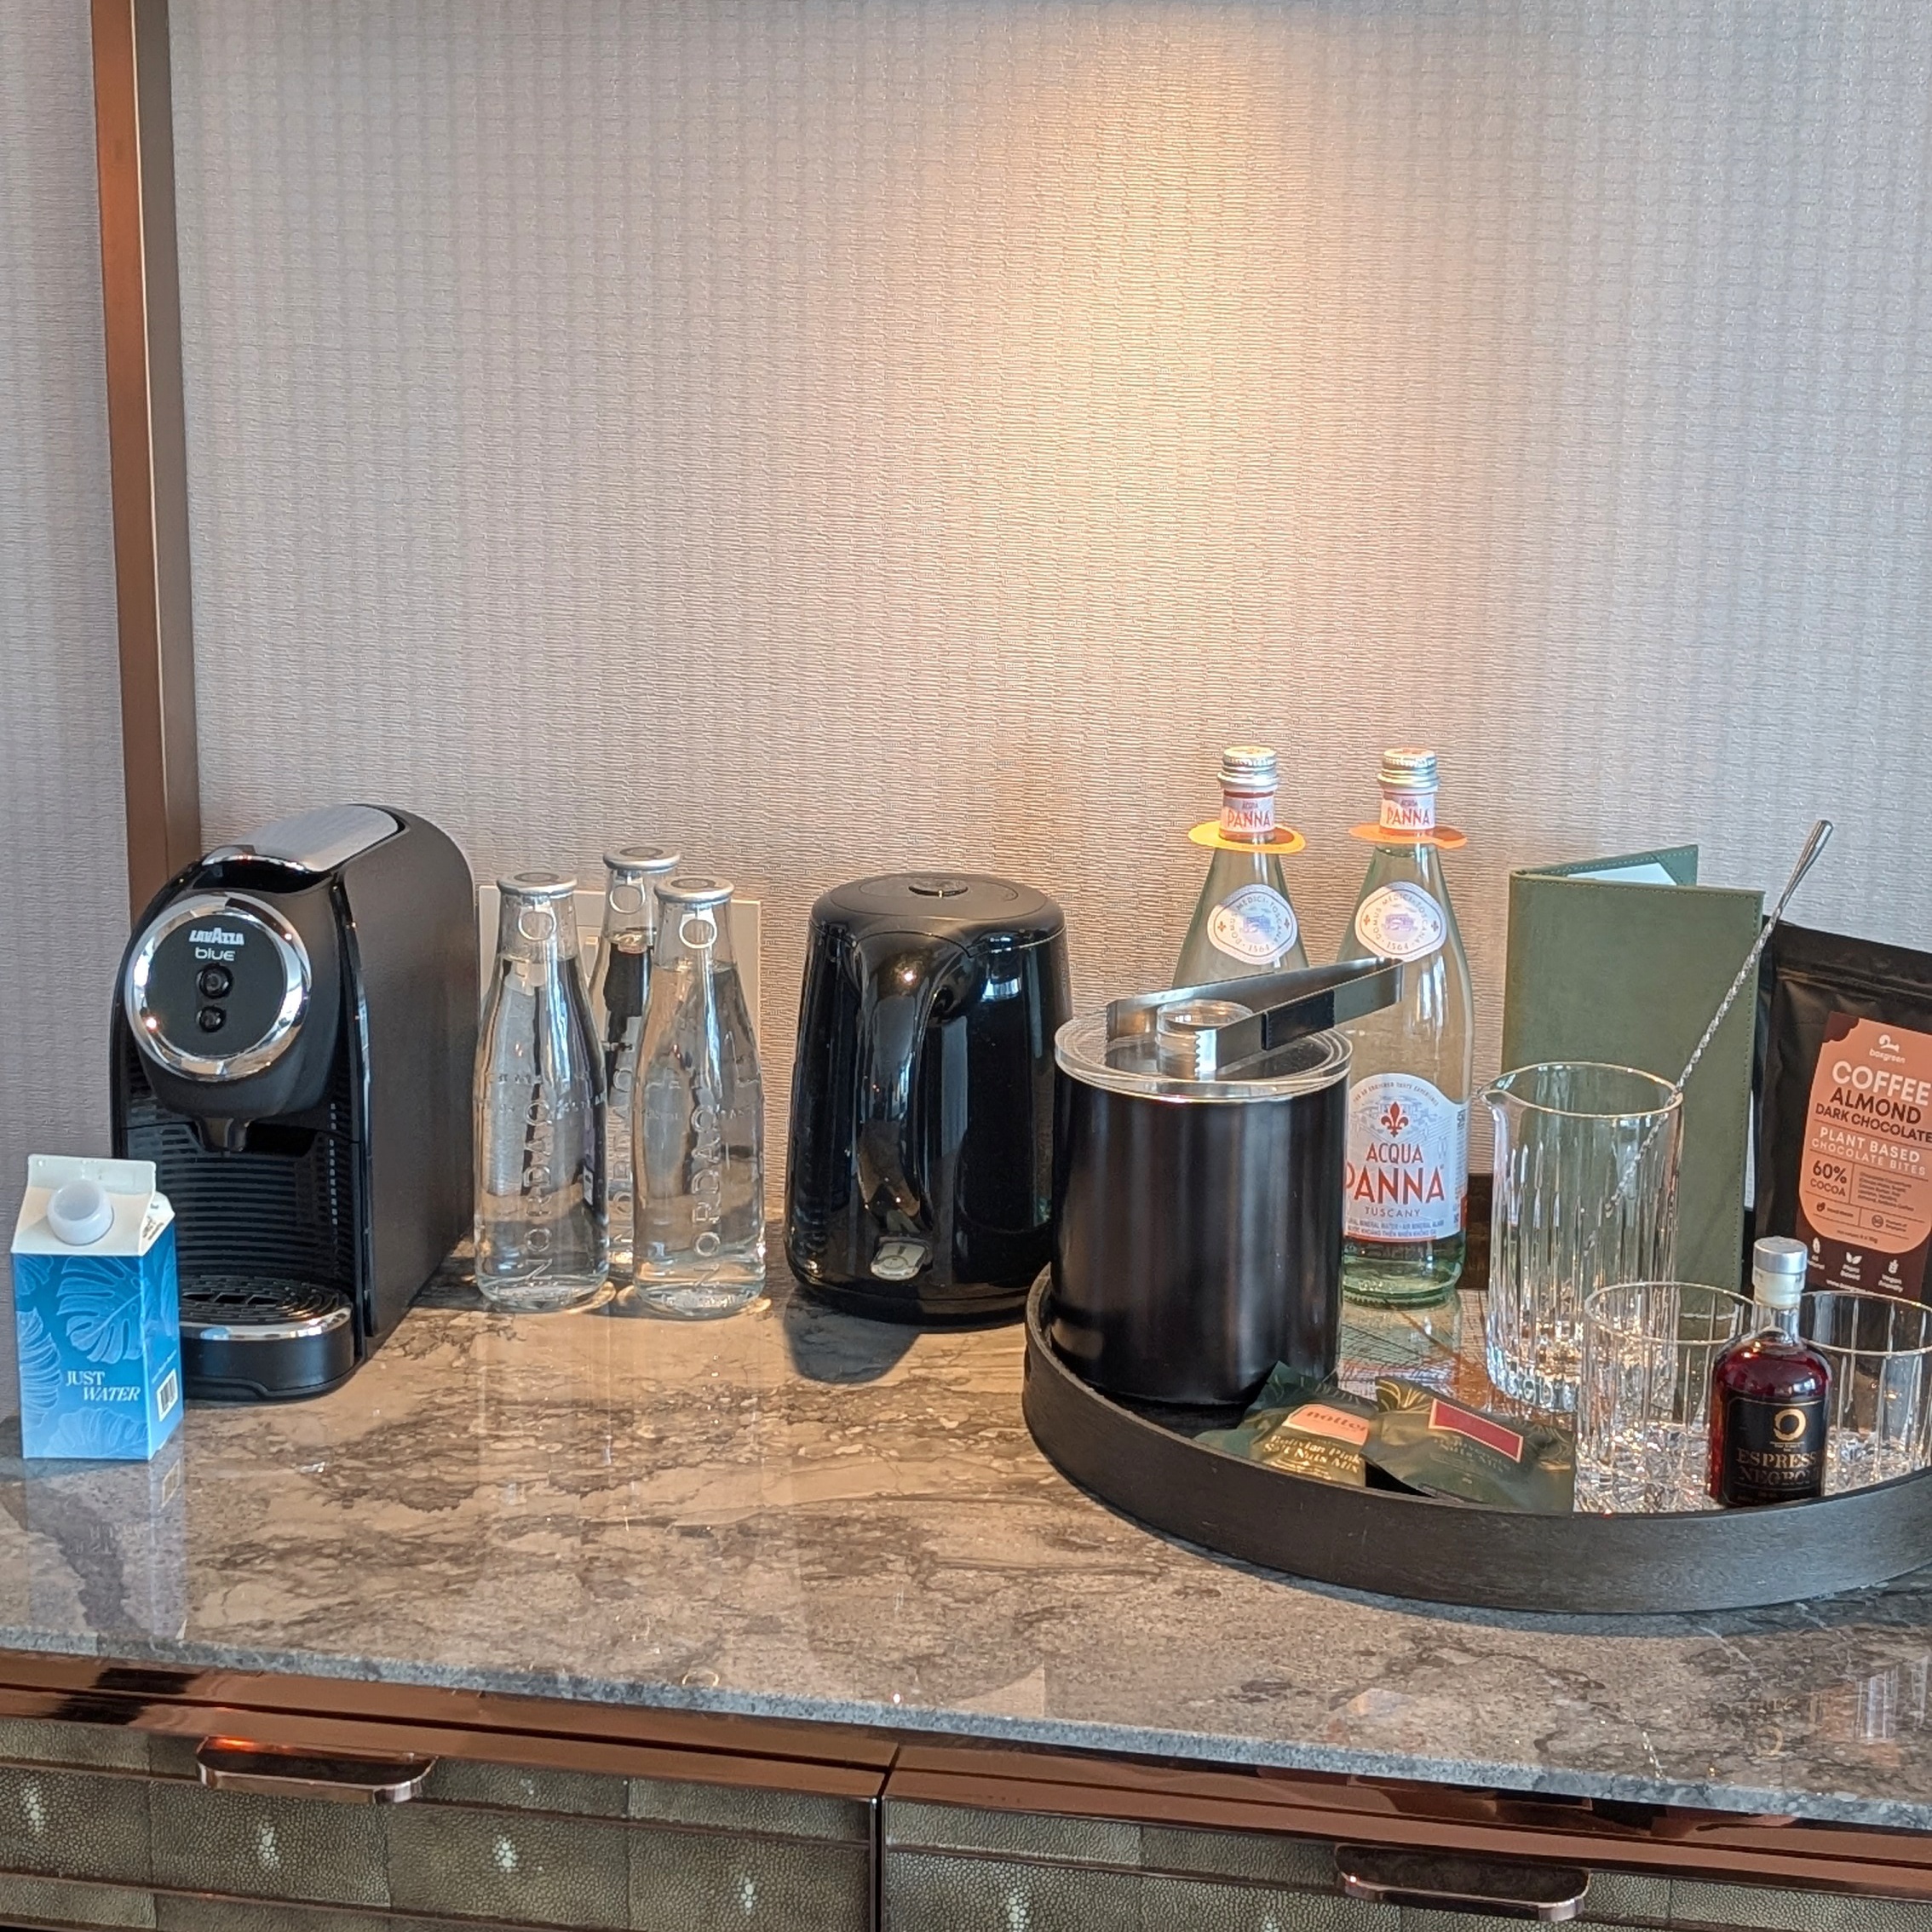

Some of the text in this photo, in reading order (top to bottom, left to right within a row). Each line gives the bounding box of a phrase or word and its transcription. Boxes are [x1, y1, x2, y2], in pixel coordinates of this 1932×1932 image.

[1228, 810, 1271, 828] PANNA
[1386, 807, 1430, 826] PANNA
[189, 928, 244, 946] LAVAZZA
[1387, 941, 1409, 951] 1564
[195, 946, 235, 961] blue
[1832, 1061, 1931, 1106] COFFEE
[1830, 1087, 1921, 1124] ALMOND
[1815, 1102, 1932, 1144] DARK CHOCOLATE
[1366, 1143, 1423, 1164] ACQUA
[1820, 1126, 1920, 1163] PLANT BASED
[1812, 1138, 1925, 1176] CHOCOLATE BITES
[1813, 1160, 1848, 1184] 60%
[1810, 1178, 1846, 1197] COCOA
[1365, 1206, 1421, 1217] TUSCANY
[66, 1370, 106, 1386] JUST
[83, 1386, 141, 1401] WATER
